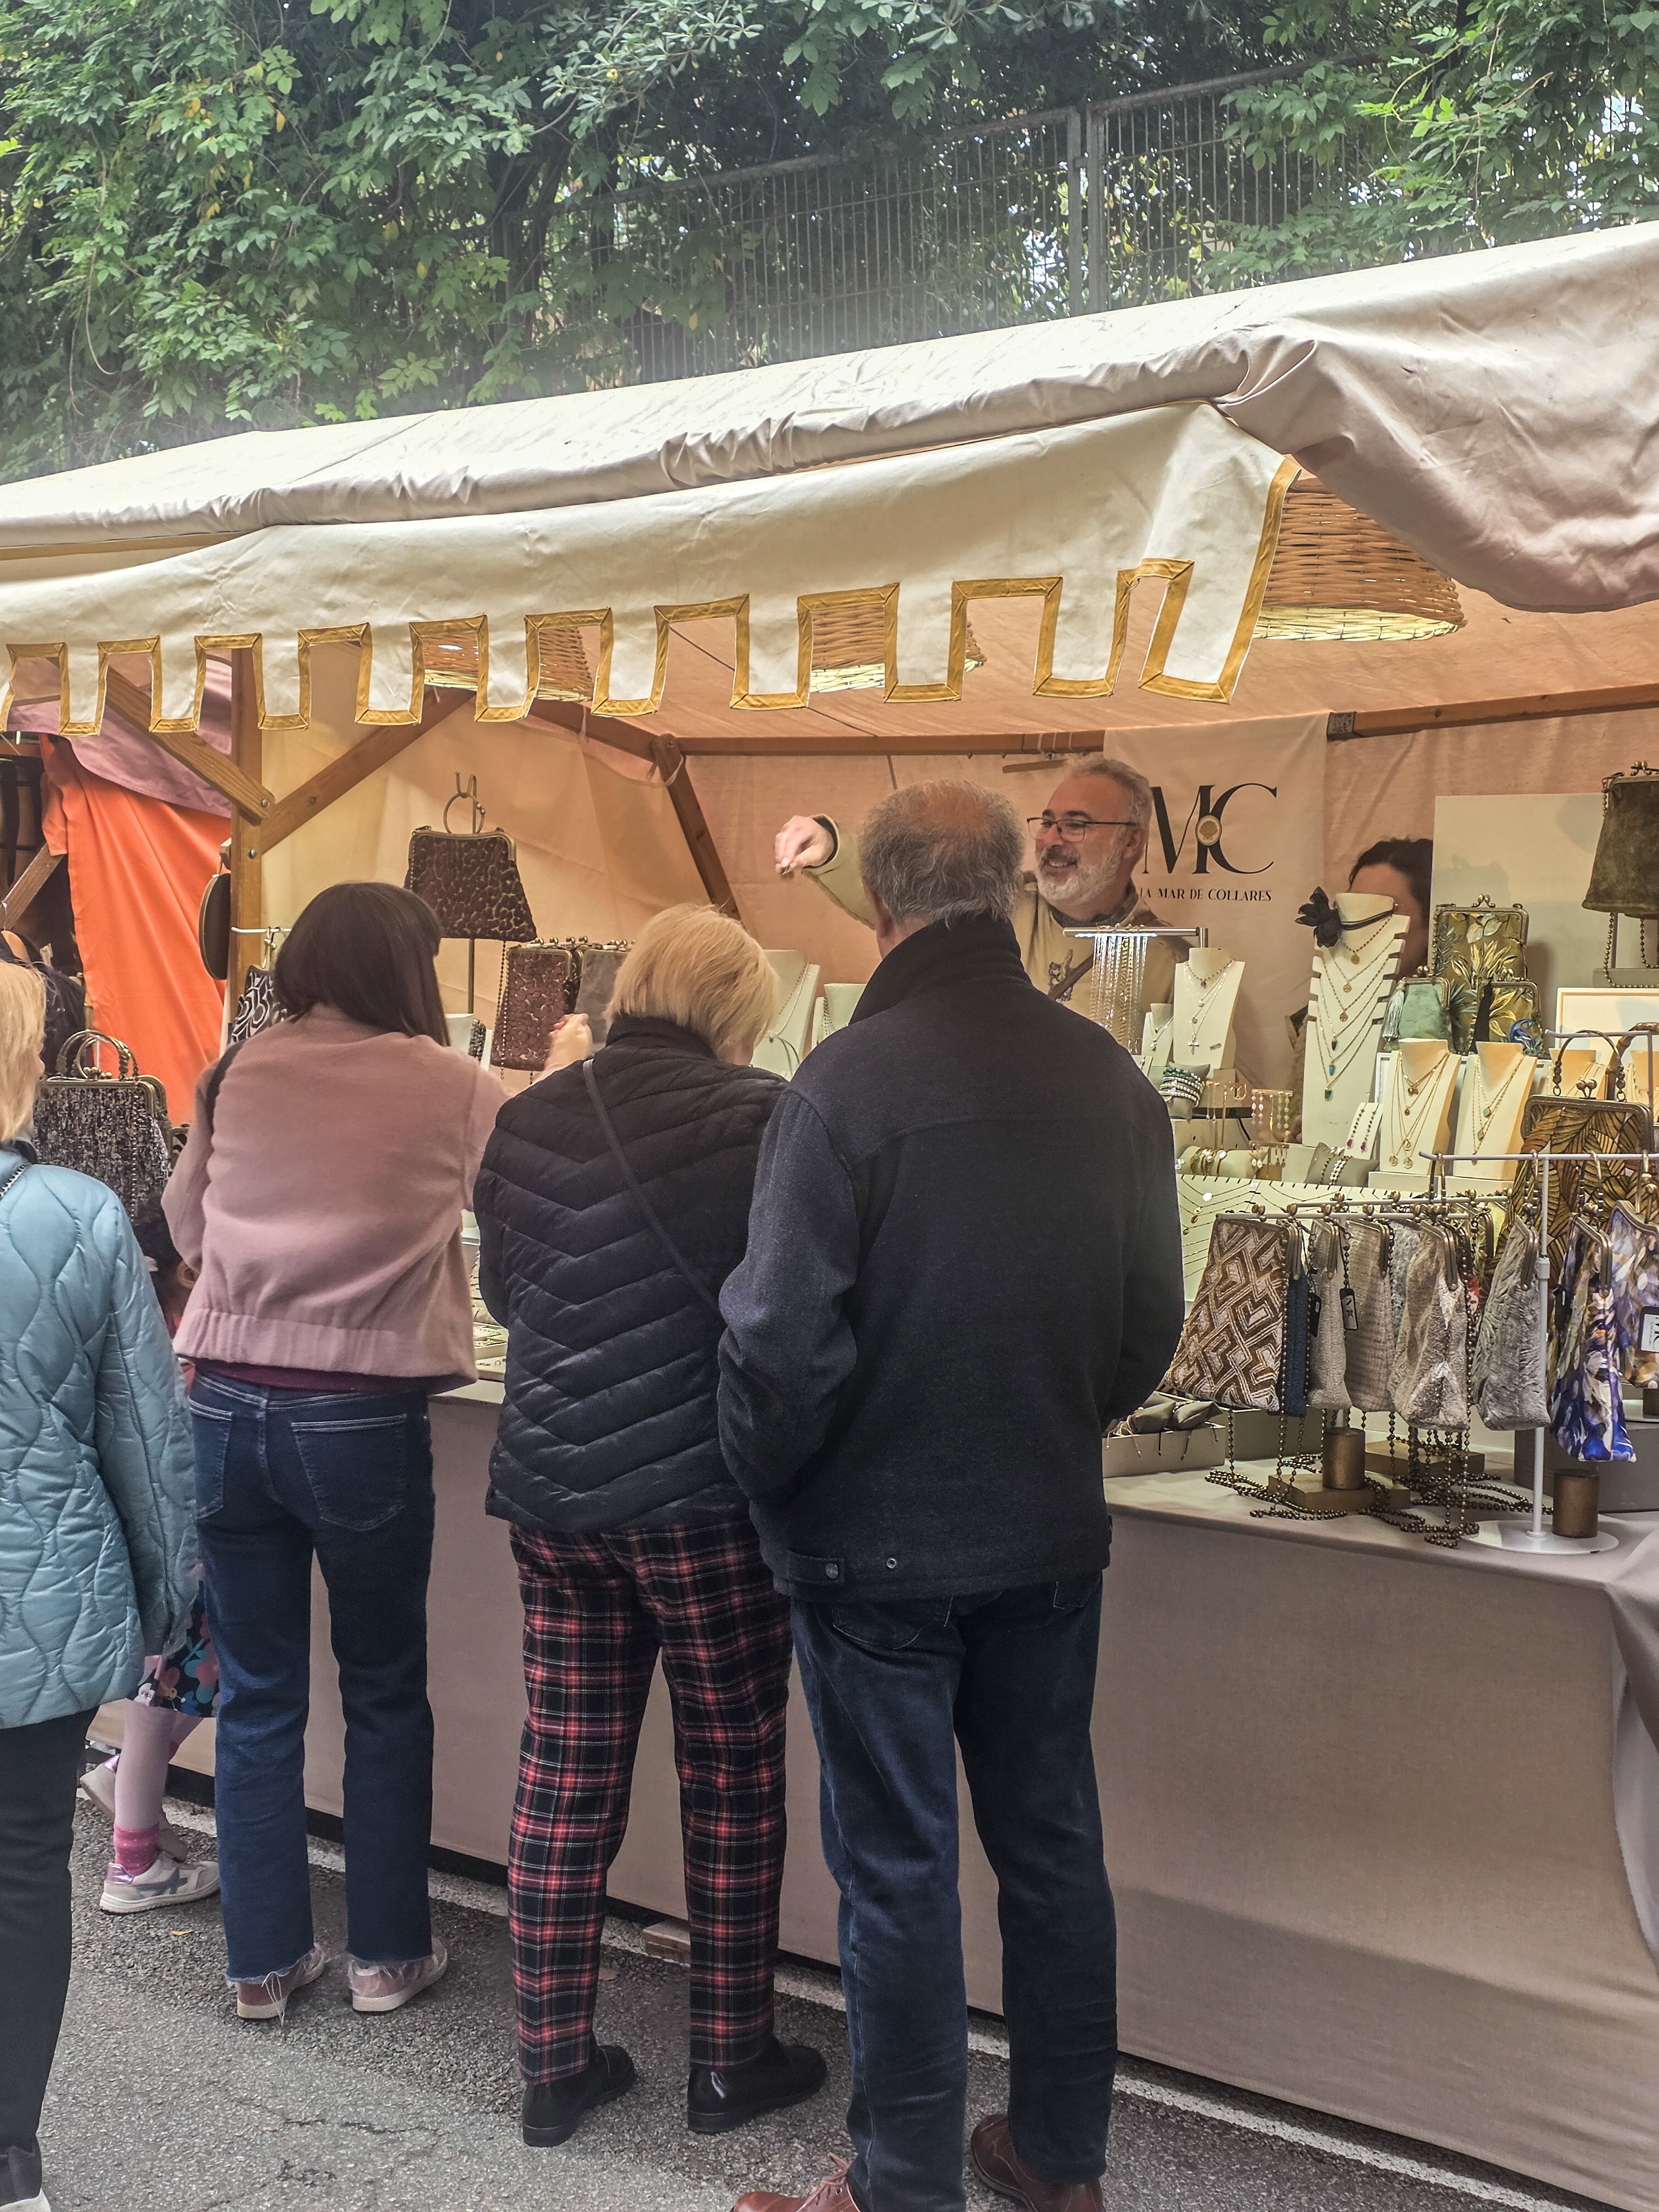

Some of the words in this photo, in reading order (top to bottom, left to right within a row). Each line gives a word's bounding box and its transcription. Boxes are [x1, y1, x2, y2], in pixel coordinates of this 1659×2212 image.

[1159, 888, 1185, 900] MAR
[1190, 888, 1203, 900] DE
[1208, 888, 1272, 901] COLLARES
